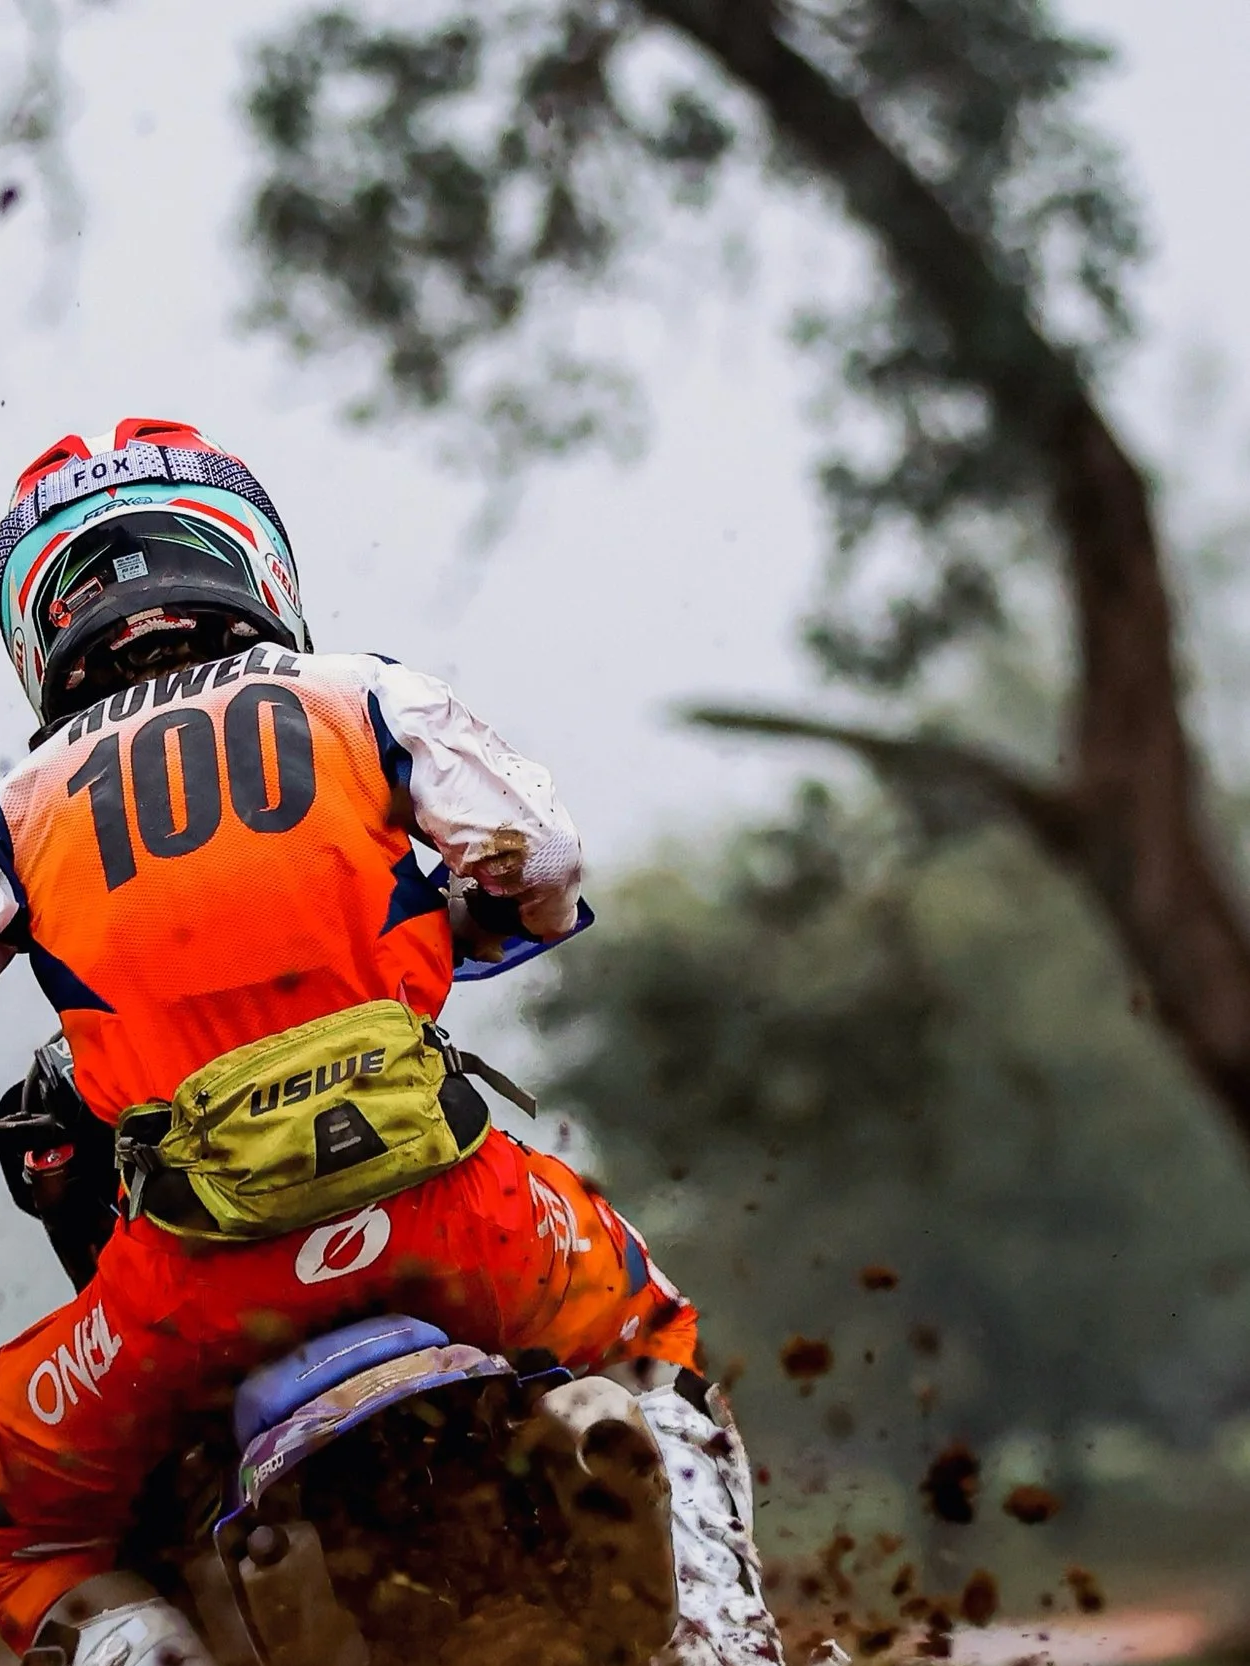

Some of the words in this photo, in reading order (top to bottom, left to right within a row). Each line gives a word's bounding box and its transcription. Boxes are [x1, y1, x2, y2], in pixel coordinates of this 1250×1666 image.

[73, 457, 130, 488] FOX
[271, 559, 298, 611] BELL
[69, 647, 301, 746] HOWELL
[67, 683, 317, 893] 100
[250, 1048, 386, 1117] USWE
